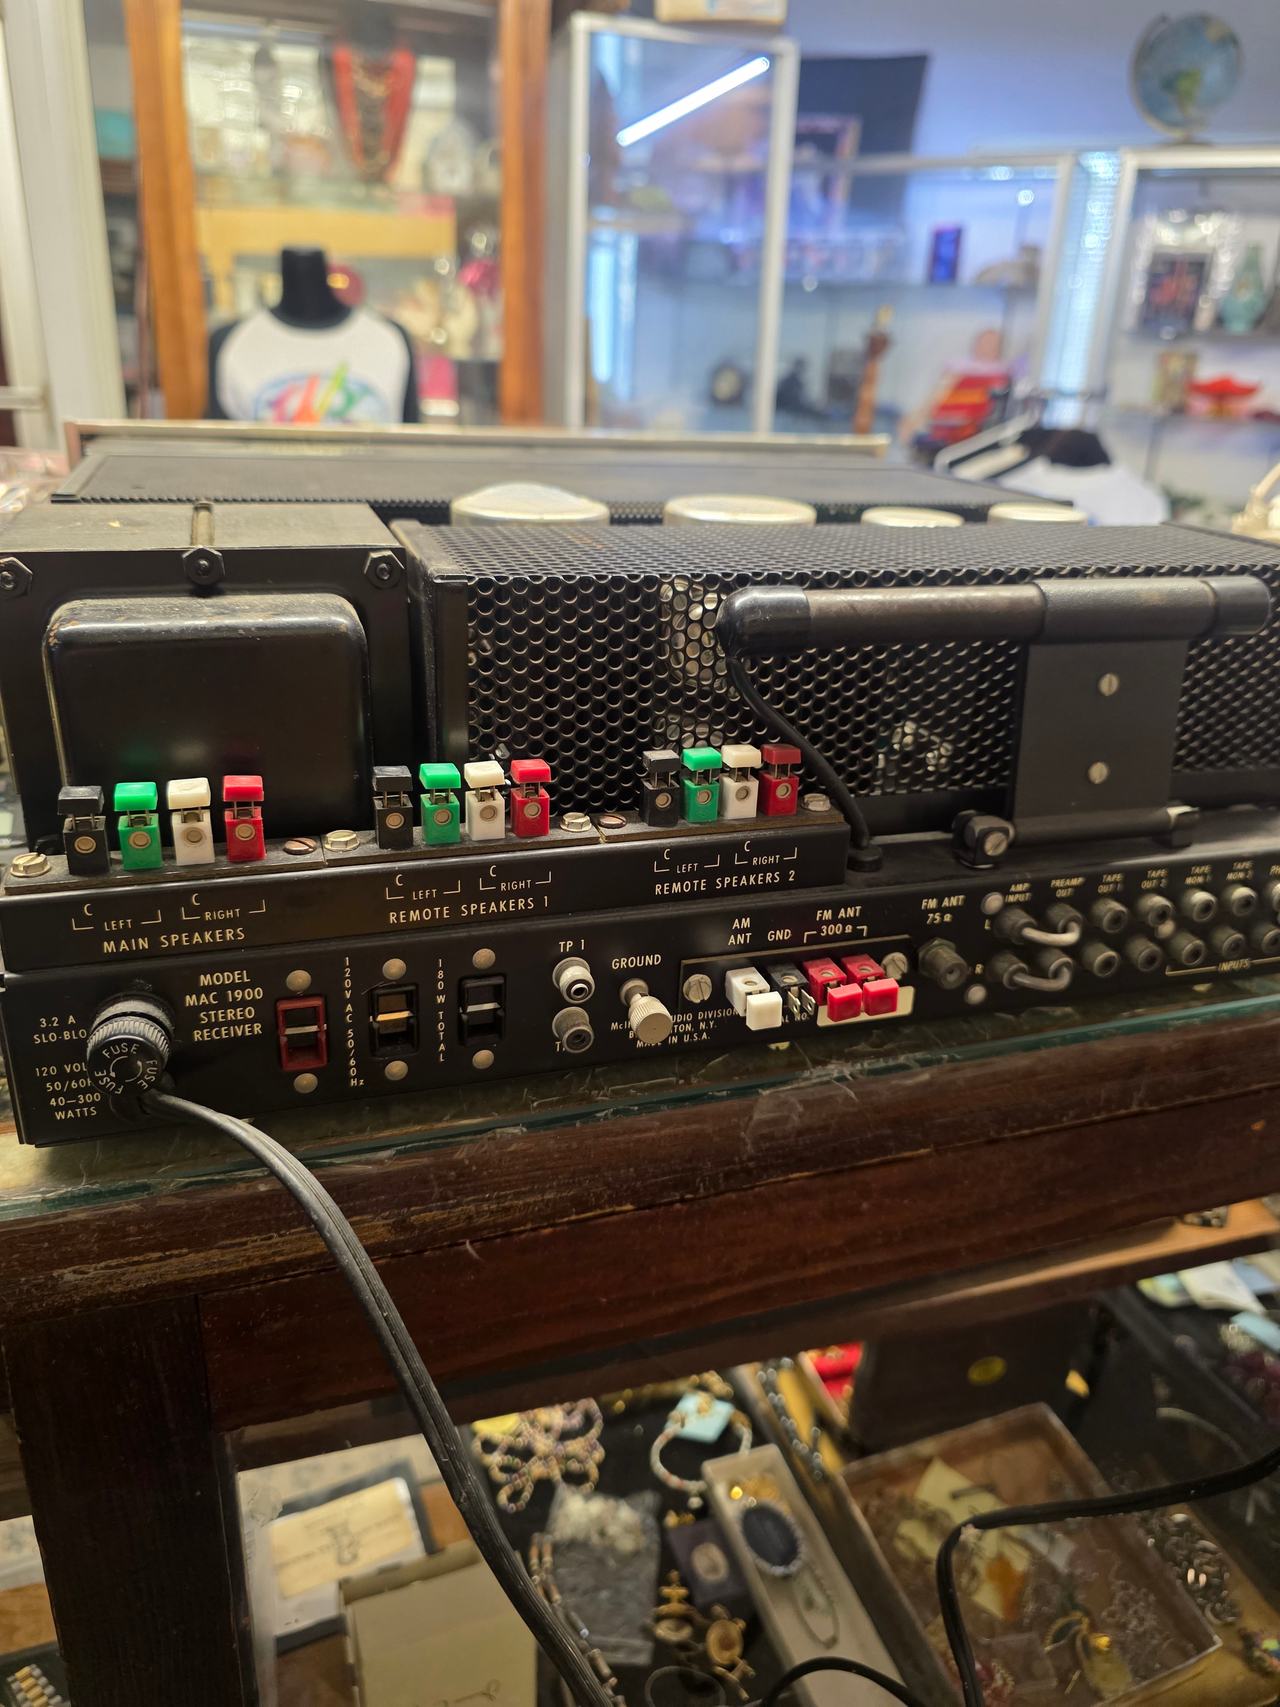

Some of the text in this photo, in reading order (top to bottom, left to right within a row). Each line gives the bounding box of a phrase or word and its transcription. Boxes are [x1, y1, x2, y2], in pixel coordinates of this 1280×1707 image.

[743, 840, 751, 852] C
[664, 848, 671, 860] C
[752, 854, 780, 866] RIGHT
[489, 865, 497, 877] C
[676, 862, 699, 874] LEFT
[395, 874, 404, 887] C
[500, 879, 532, 892] RIGHT
[655, 869, 796, 896] REMOTE SPEAKERS 2
[1051, 877, 1085, 888] PREAMP
[192, 893, 201, 906] C
[412, 889, 437, 901] LEFT
[921, 894, 965, 910] FM ANT
[83, 903, 93, 917] C
[204, 908, 241, 922] RIGHT
[389, 895, 549, 924] REMOTE SPEAKERS 1
[816, 905, 862, 921] FM ANT
[104, 919, 133, 932] LEFT
[732, 917, 750, 930] AM
[103, 927, 246, 954] MAIN SPEAKERS
[728, 932, 752, 946] ANT
[767, 928, 792, 942] GND
[558, 939, 585, 953] TP 1
[611, 954, 662, 970] GROUND
[200, 970, 251, 987] MODEL
[185, 987, 264, 1007] MAC 1900
[40, 1015, 76, 1028] 3.2 A
[200, 1006, 256, 1024] STEREO
[670, 1012, 693, 1024] UDIO
[33, 1029, 87, 1045] SLO-BLO
[193, 1023, 263, 1042] RECEIVER
[668, 1036, 678, 1046] IN
[683, 1031, 711, 1043] U.S.A.
[102, 1042, 140, 1059] FUSE
[35, 1061, 88, 1077] 120 VOL
[137, 1059, 158, 1090] FUSE
[46, 1077, 92, 1092] 50/60
[94, 1069, 124, 1095] FUSE
[54, 1106, 97, 1121] WATTS
